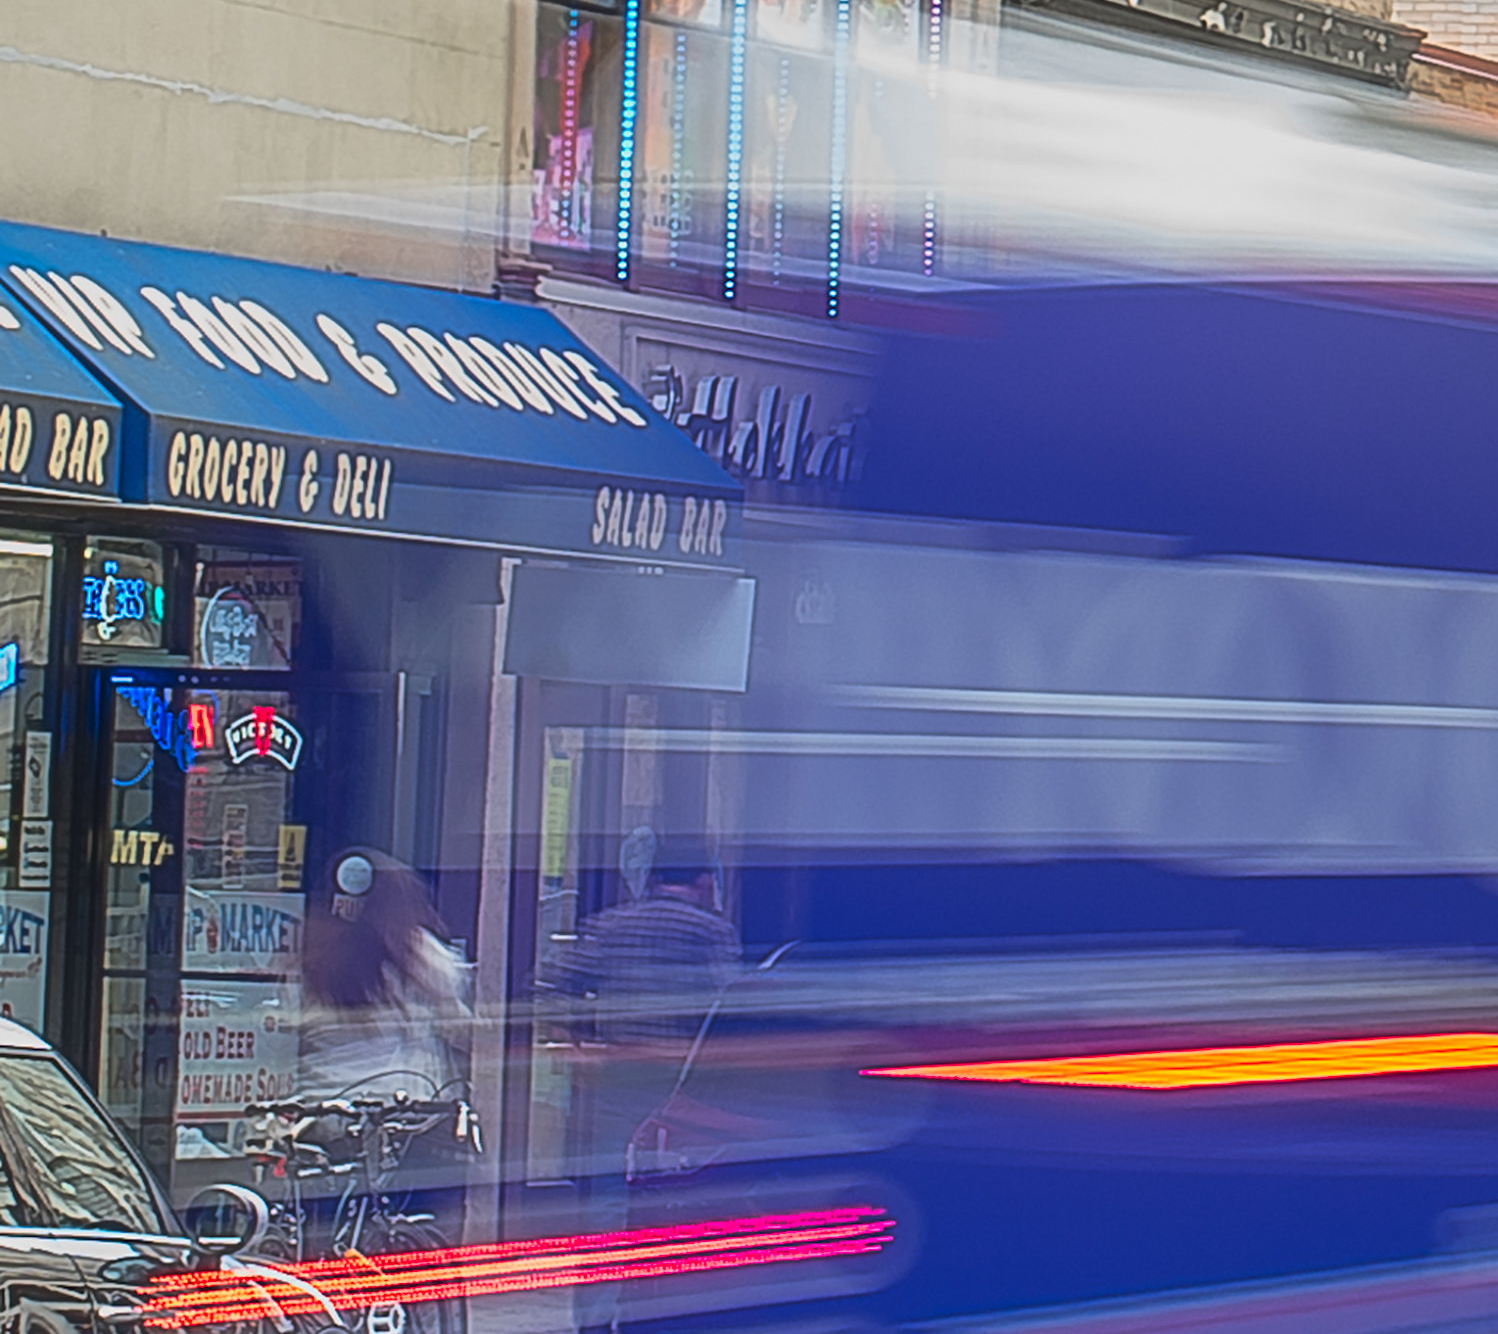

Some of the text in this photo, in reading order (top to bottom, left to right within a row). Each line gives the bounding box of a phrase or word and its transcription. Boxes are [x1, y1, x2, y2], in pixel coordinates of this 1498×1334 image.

[8, 265, 155, 359] VIP
[140, 286, 330, 383] FOOD
[316, 313, 397, 395] &
[376, 322, 647, 427] PRODUCE
[49, 413, 110, 486] BAR
[168, 431, 391, 520] GROCERY & DELI
[592, 485, 728, 557] SALAD BAR
[184, 1031, 212, 1060] OLD
[182, 1074, 251, 1104] OMEMADE
